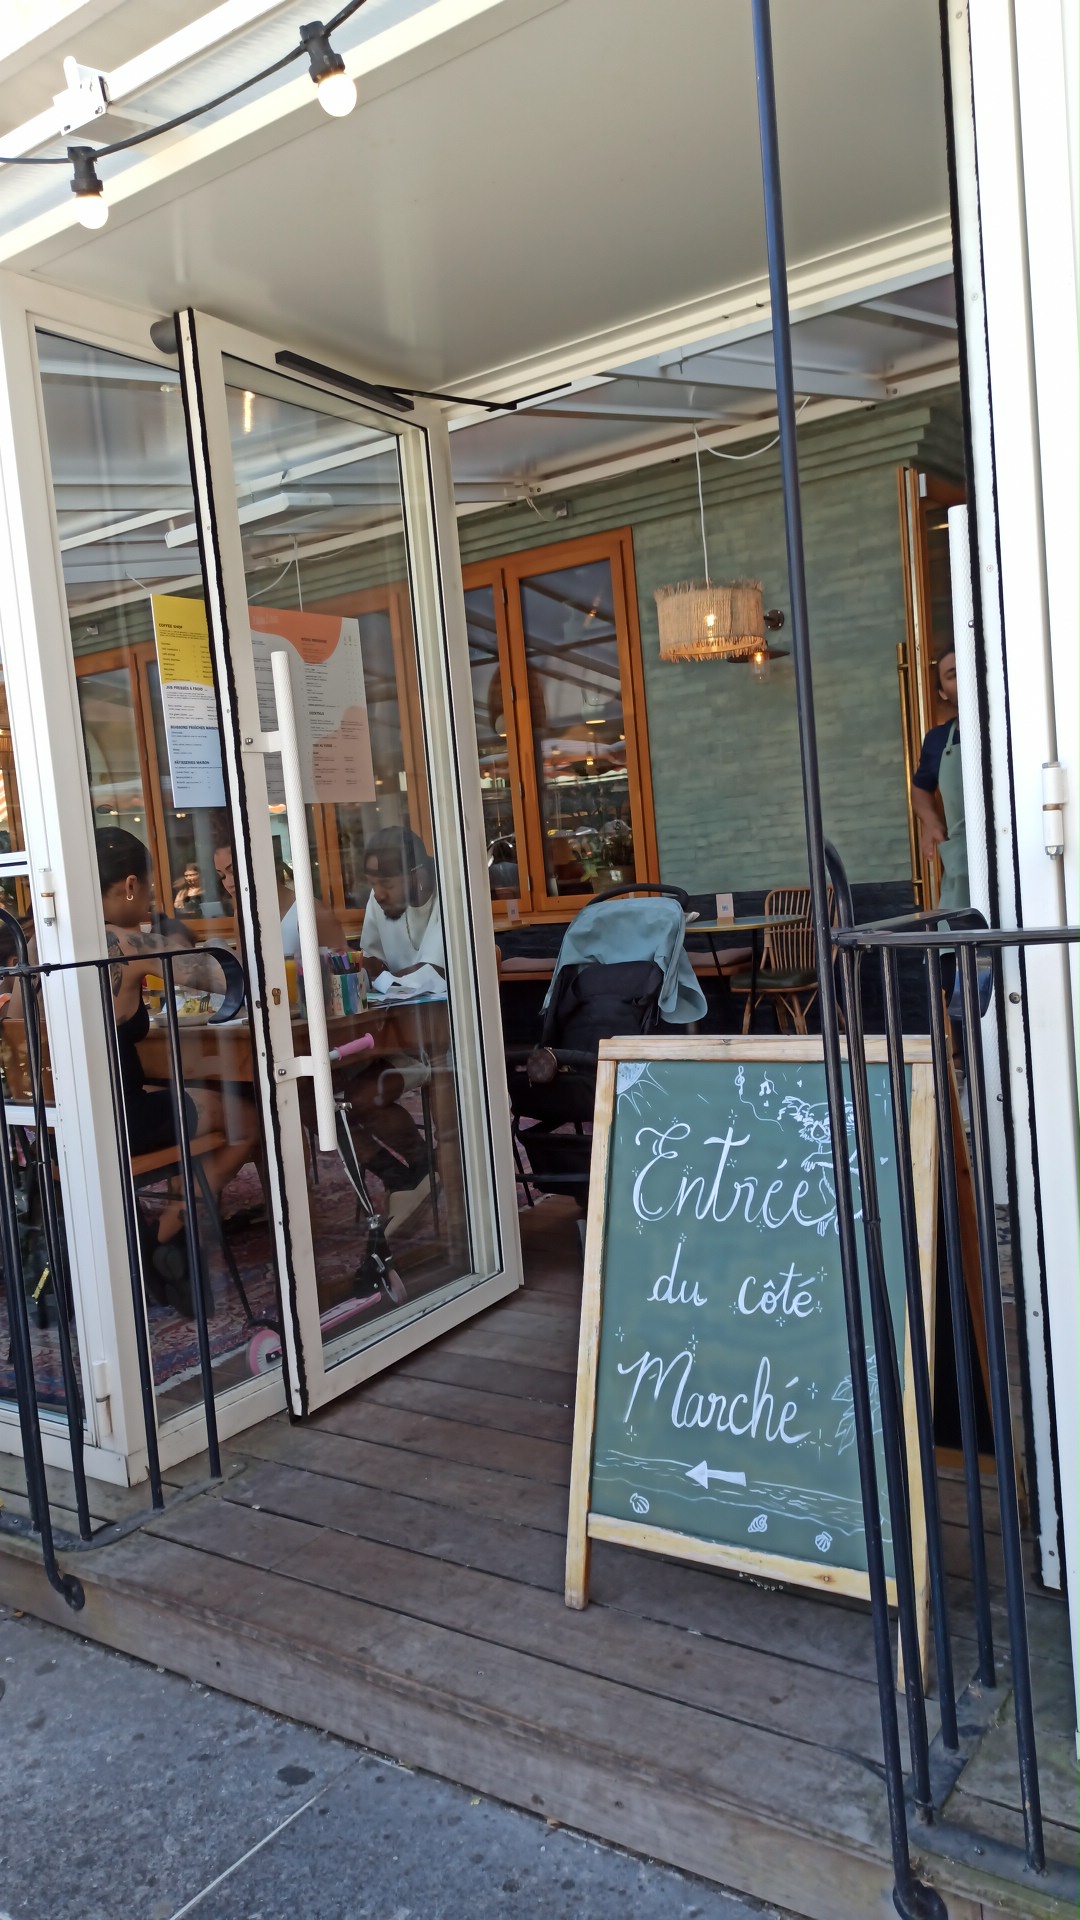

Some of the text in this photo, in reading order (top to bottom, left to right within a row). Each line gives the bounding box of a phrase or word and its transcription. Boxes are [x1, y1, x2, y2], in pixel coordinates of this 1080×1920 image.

[632, 1122, 836, 1229] Entrée
[646, 1242, 816, 1318] du côté
[617, 1350, 812, 1444] Marché
